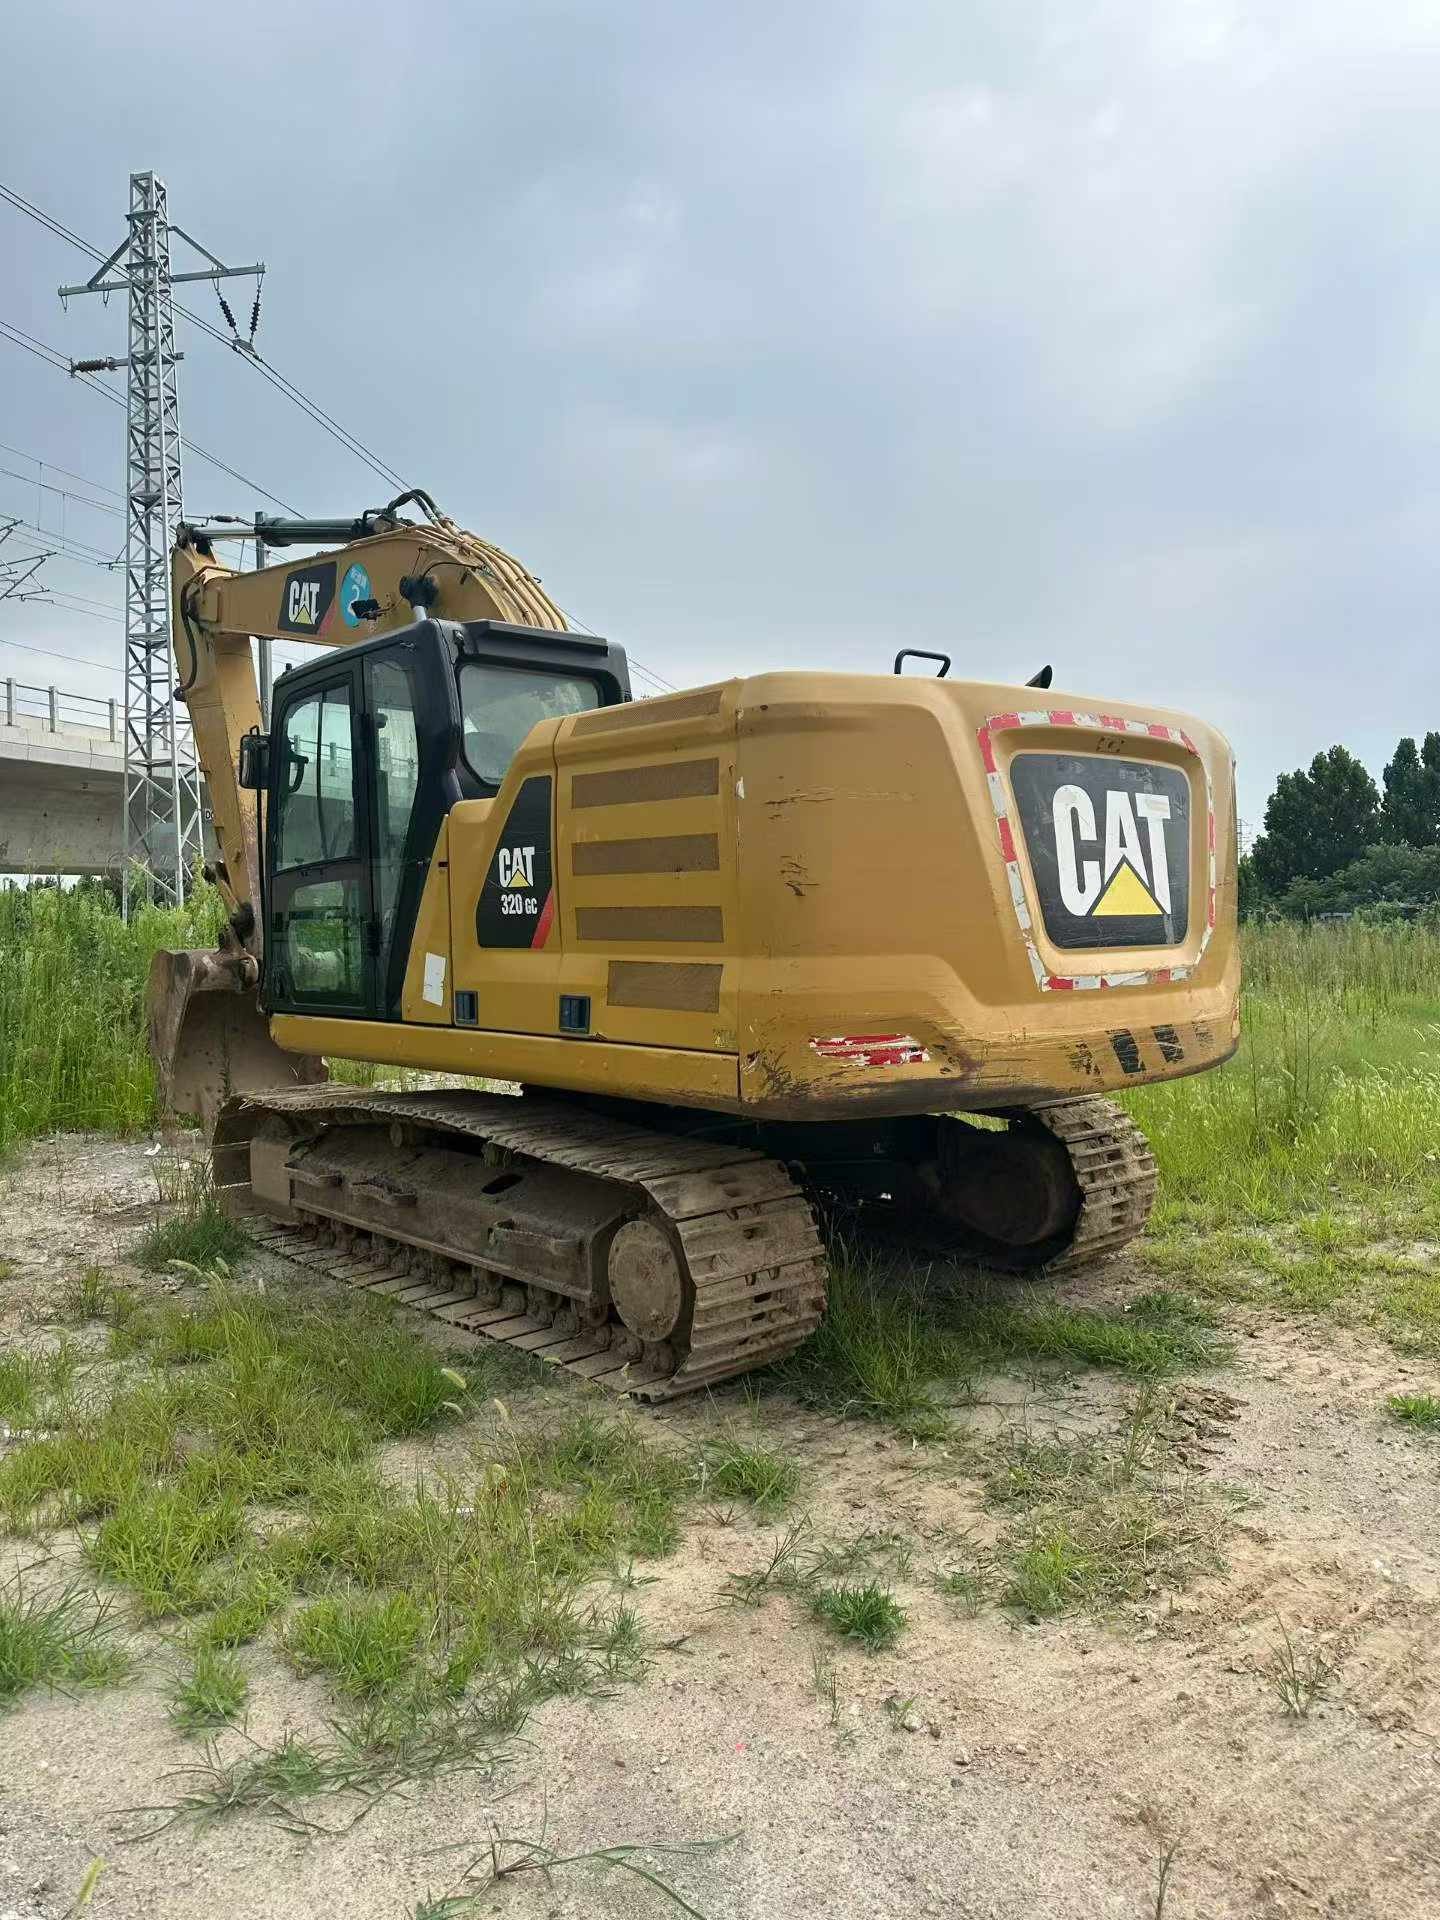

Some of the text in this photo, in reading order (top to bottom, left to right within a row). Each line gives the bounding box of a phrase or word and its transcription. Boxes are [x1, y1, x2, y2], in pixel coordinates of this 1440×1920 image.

[288, 580, 320, 625] CAT
[499, 846, 535, 888] CAT
[1052, 784, 1172, 917] CAT
[501, 894, 537, 915] 320 GC
